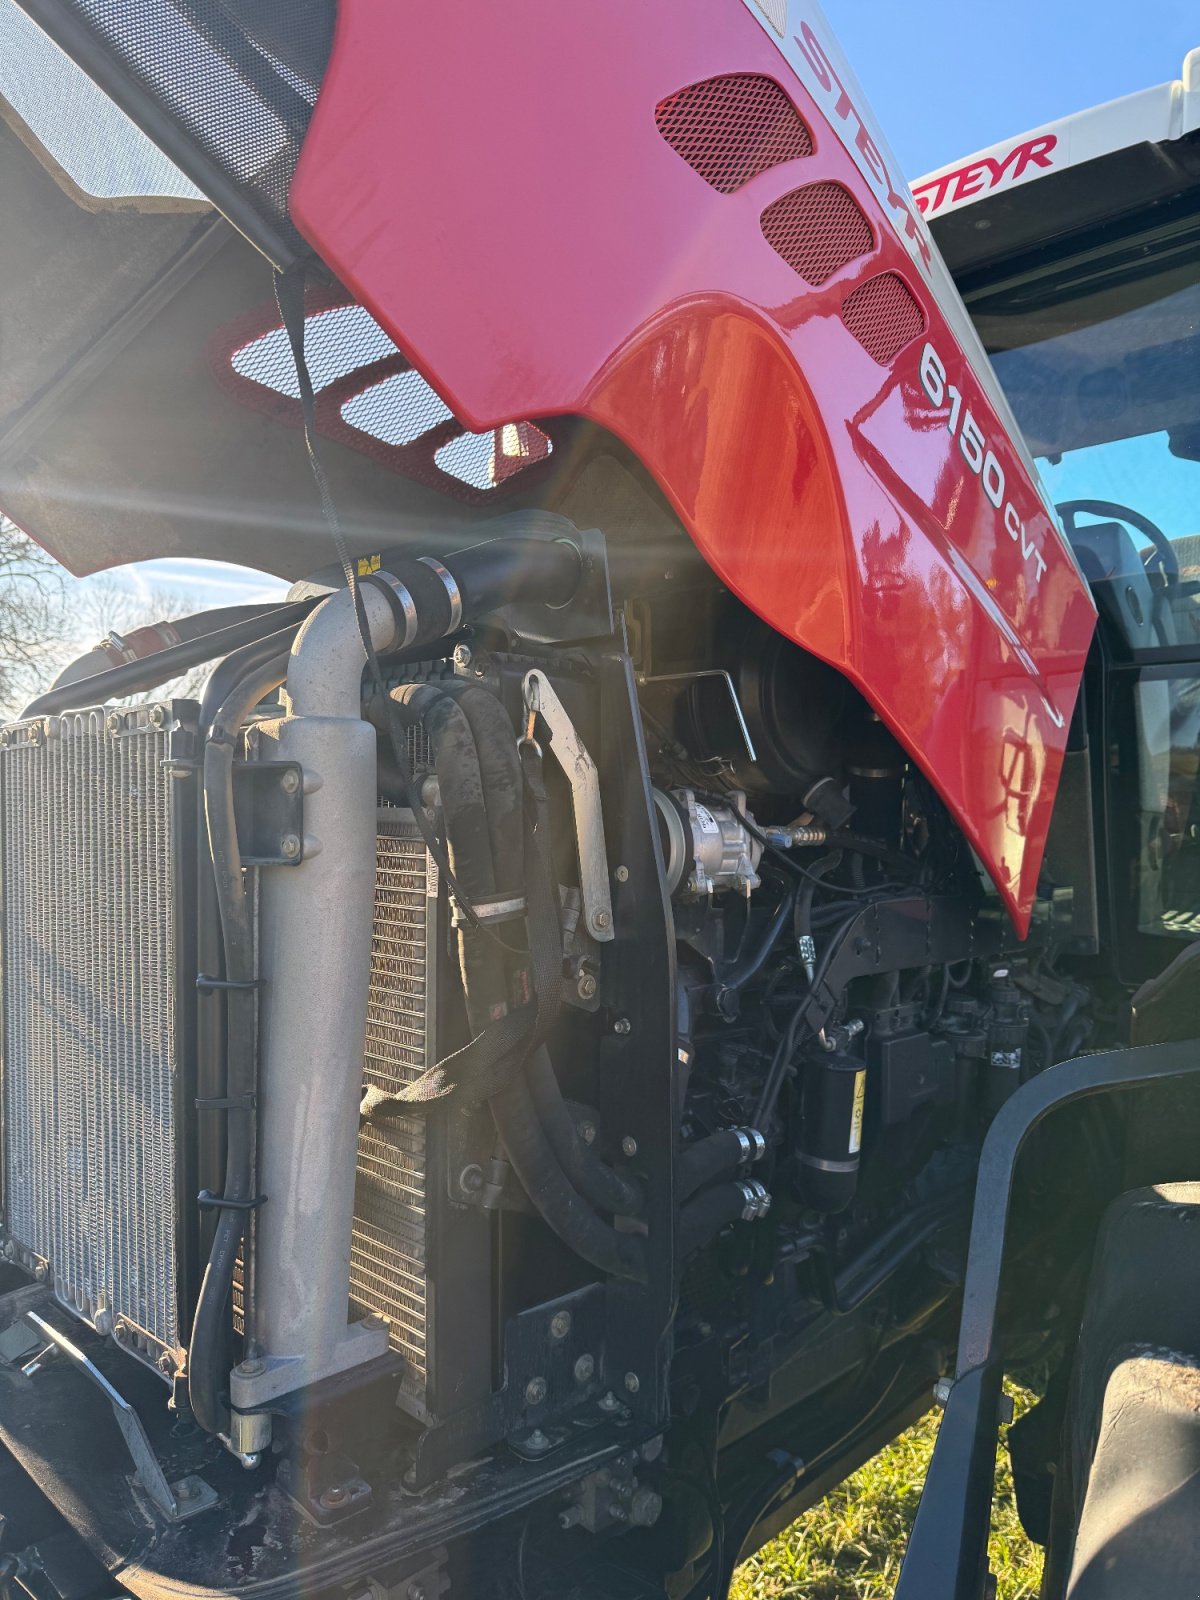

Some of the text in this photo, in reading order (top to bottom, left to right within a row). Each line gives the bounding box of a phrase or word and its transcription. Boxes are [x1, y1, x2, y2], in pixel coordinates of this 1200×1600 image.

[793, 20, 932, 278] STEYR
[918, 342, 1048, 584] 6150 CVT
